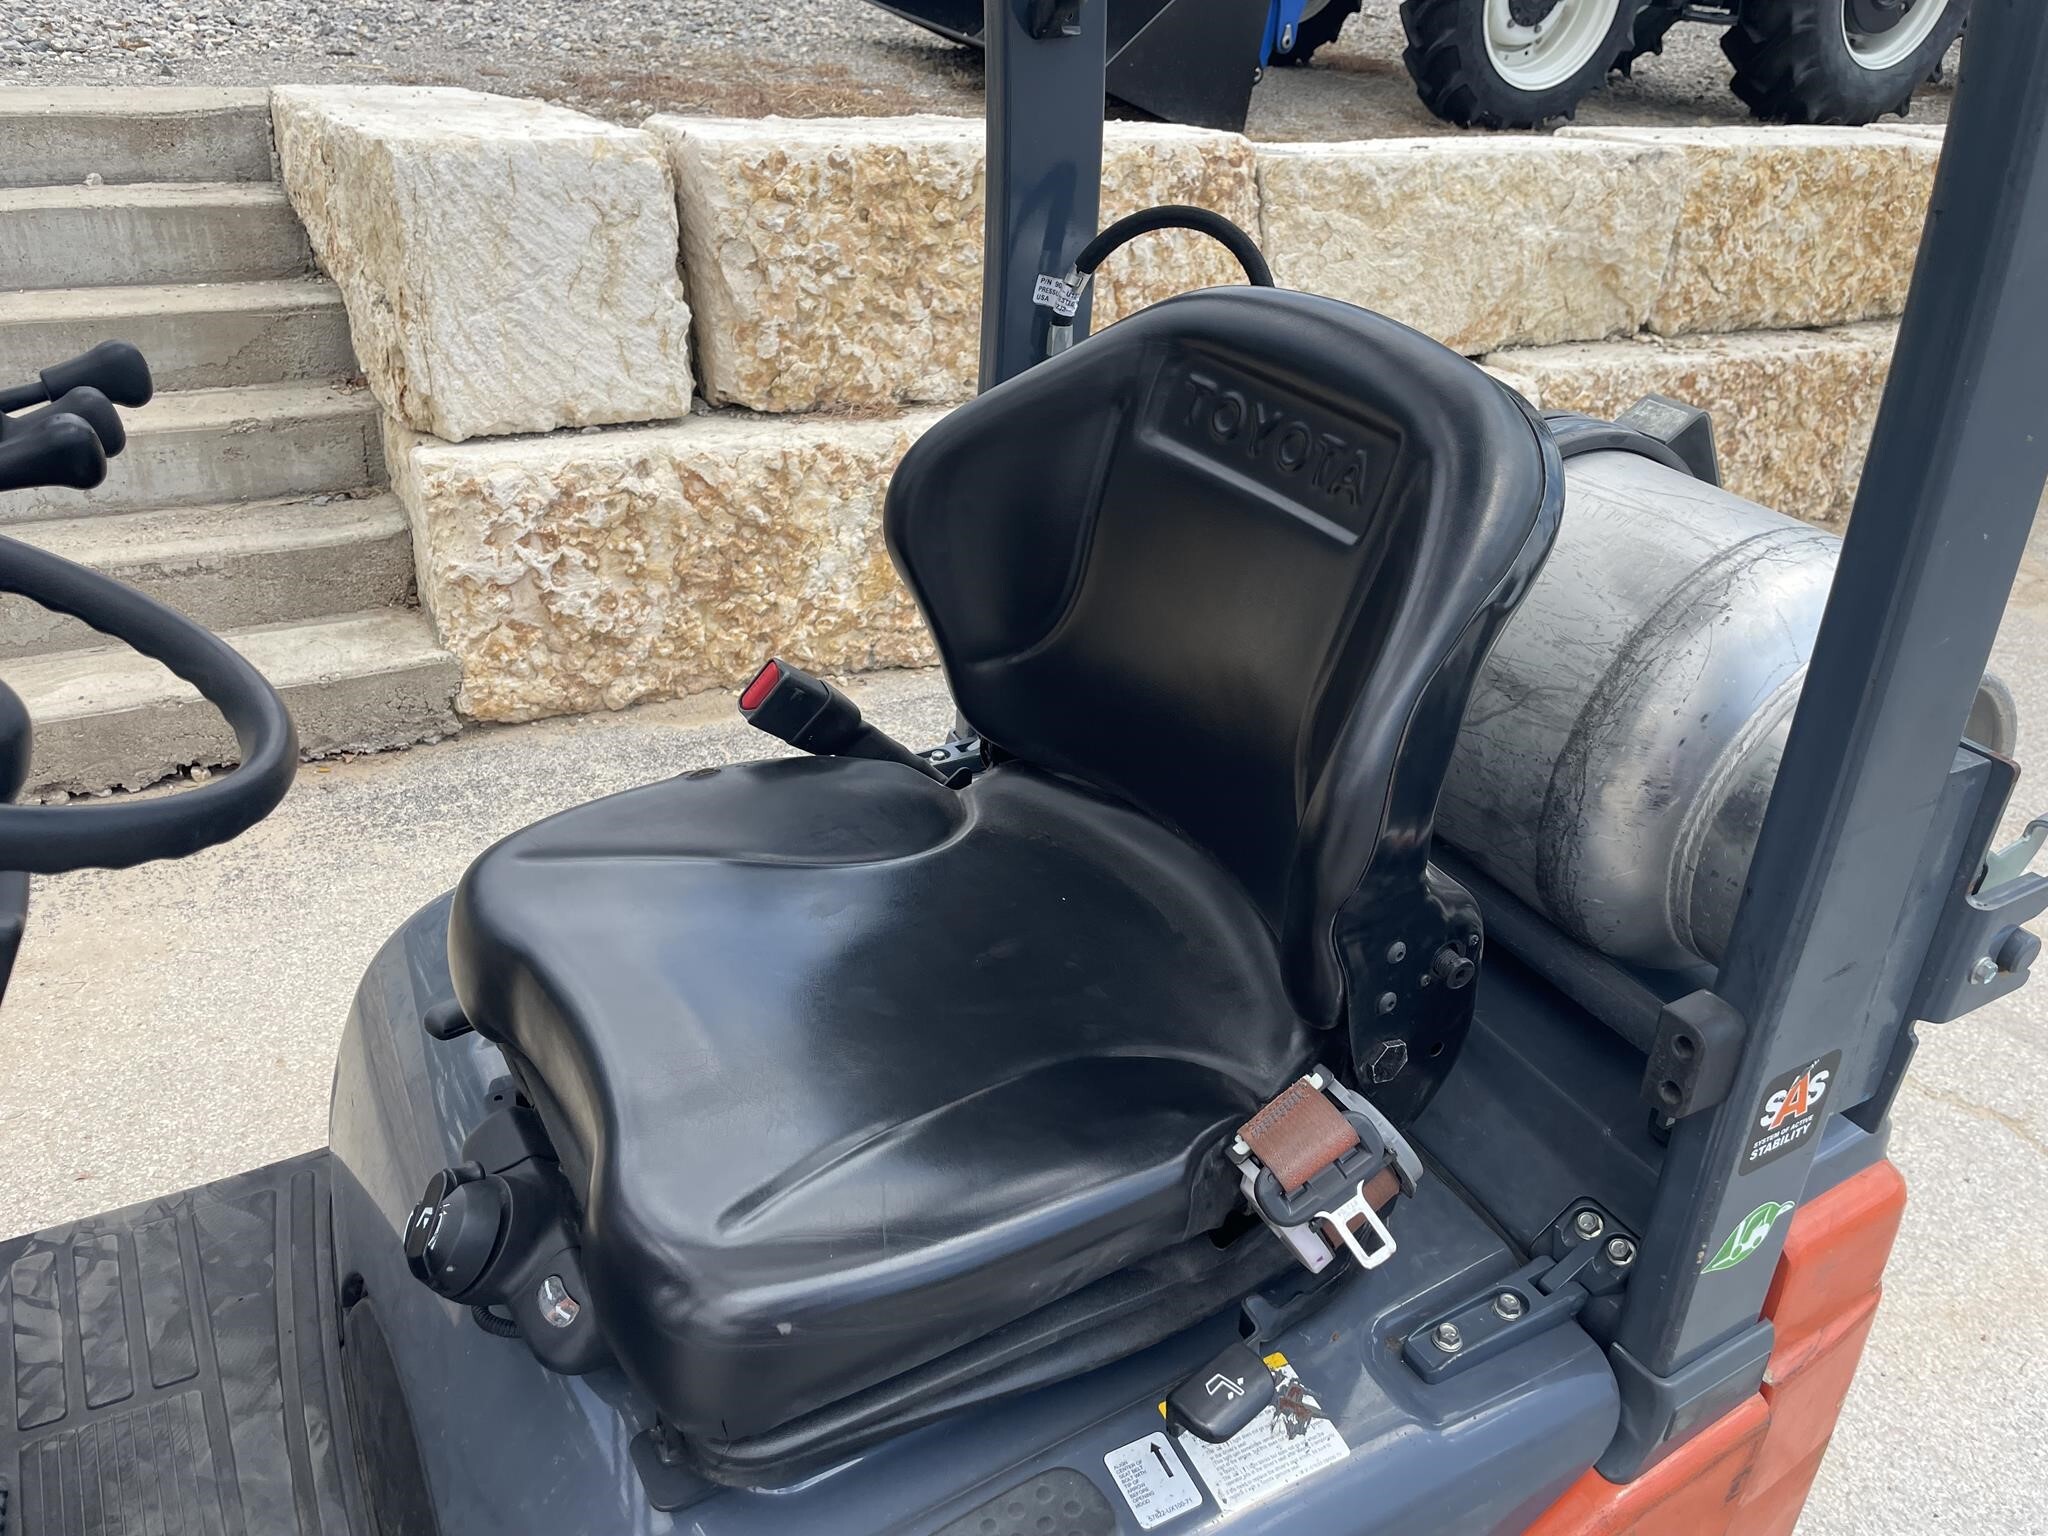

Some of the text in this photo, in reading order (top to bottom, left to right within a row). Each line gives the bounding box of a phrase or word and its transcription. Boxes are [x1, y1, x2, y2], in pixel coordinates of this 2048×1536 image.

[1040, 277, 1052, 285] P/N
[1185, 372, 1367, 506] TOYOTA
[1760, 1070, 1829, 1131] SAS
[1750, 1122, 1811, 1161] STABILITY
[1753, 1114, 1814, 1149] SYSTEM OF ACTIVE
[1132, 1490, 1155, 1504] OPENING
